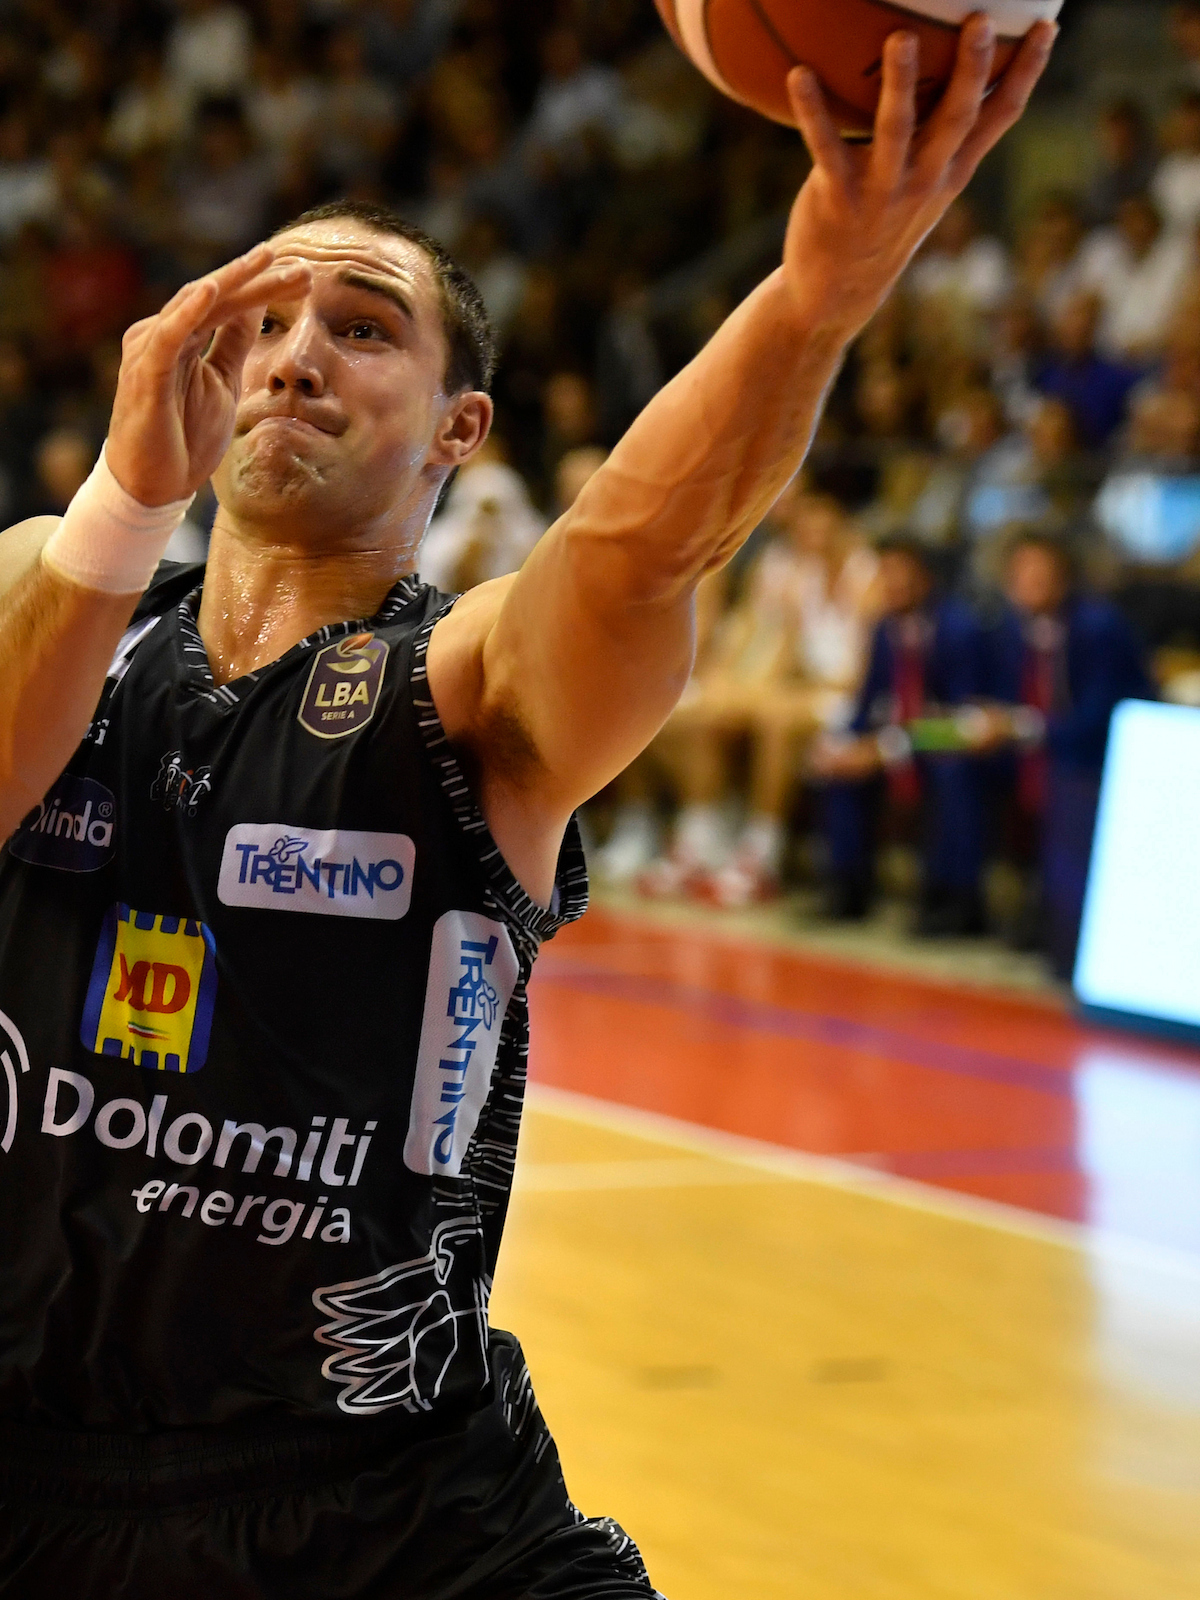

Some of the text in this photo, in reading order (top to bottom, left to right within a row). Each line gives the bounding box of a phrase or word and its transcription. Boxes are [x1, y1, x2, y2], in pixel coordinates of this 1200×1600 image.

[314, 681, 369, 707] LBA
[320, 710, 355, 721] SERIE A
[235, 843, 404, 899] TRENTINO
[113, 952, 191, 1014] MD
[432, 935, 499, 1165] TRENTINO
[40, 1066, 379, 1188] Dolomiti
[130, 1179, 352, 1246] energia
